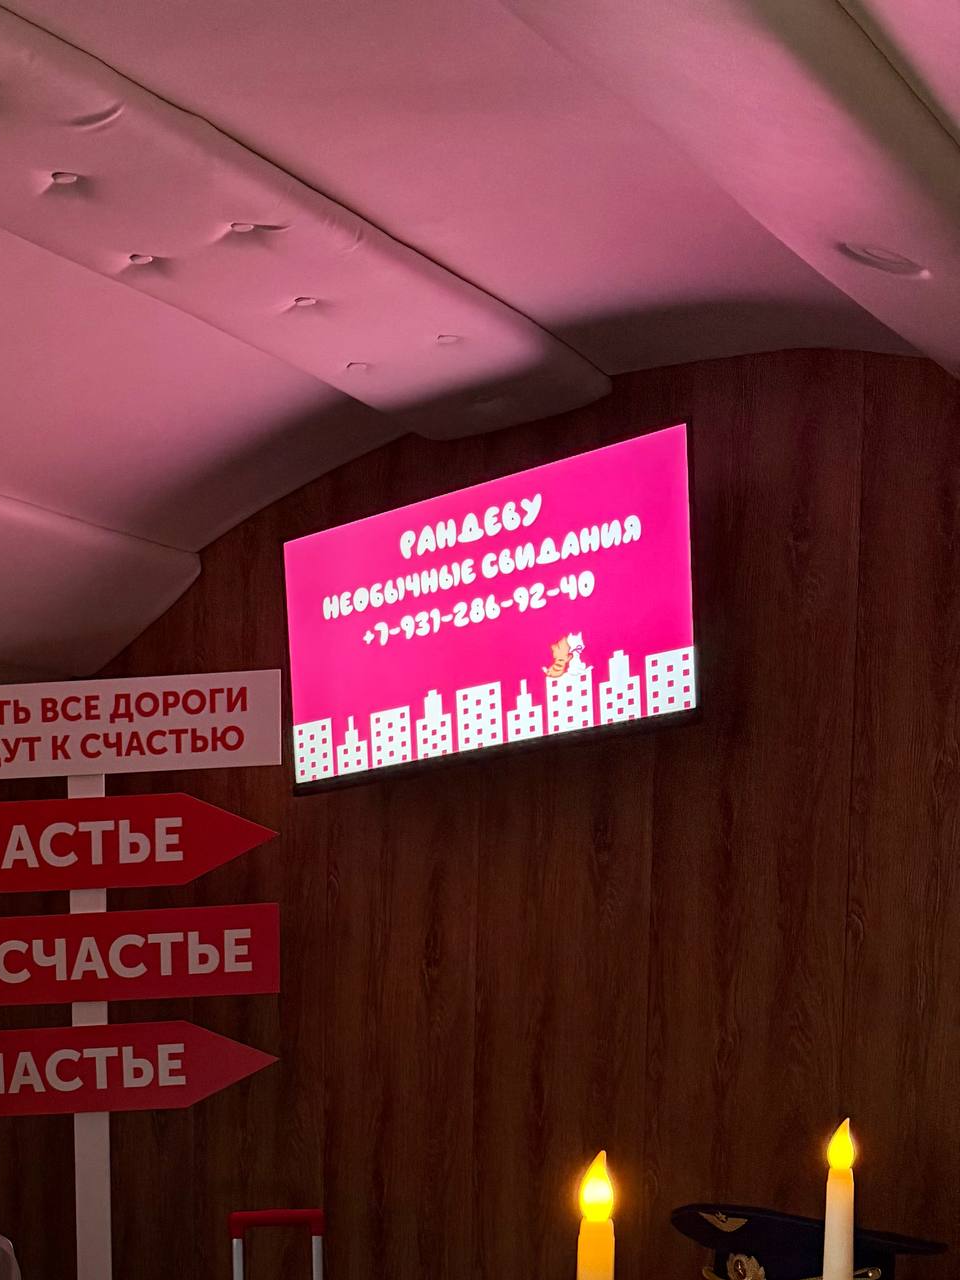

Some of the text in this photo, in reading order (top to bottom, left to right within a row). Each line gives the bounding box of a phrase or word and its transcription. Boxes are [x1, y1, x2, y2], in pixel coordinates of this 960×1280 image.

[400, 494, 542, 559] РАНДЕВУ
[323, 514, 641, 620] НЕОБЫЧНЫЕ СВИДАНИЯ
[363, 570, 595, 646] +7-931-286-92-40
[41, 695, 100, 723] ВСЕ
[109, 686, 248, 723] ДОРОГИ
[52, 735, 72, 760] К
[80, 725, 245, 758] СЧАСТЬЮ
